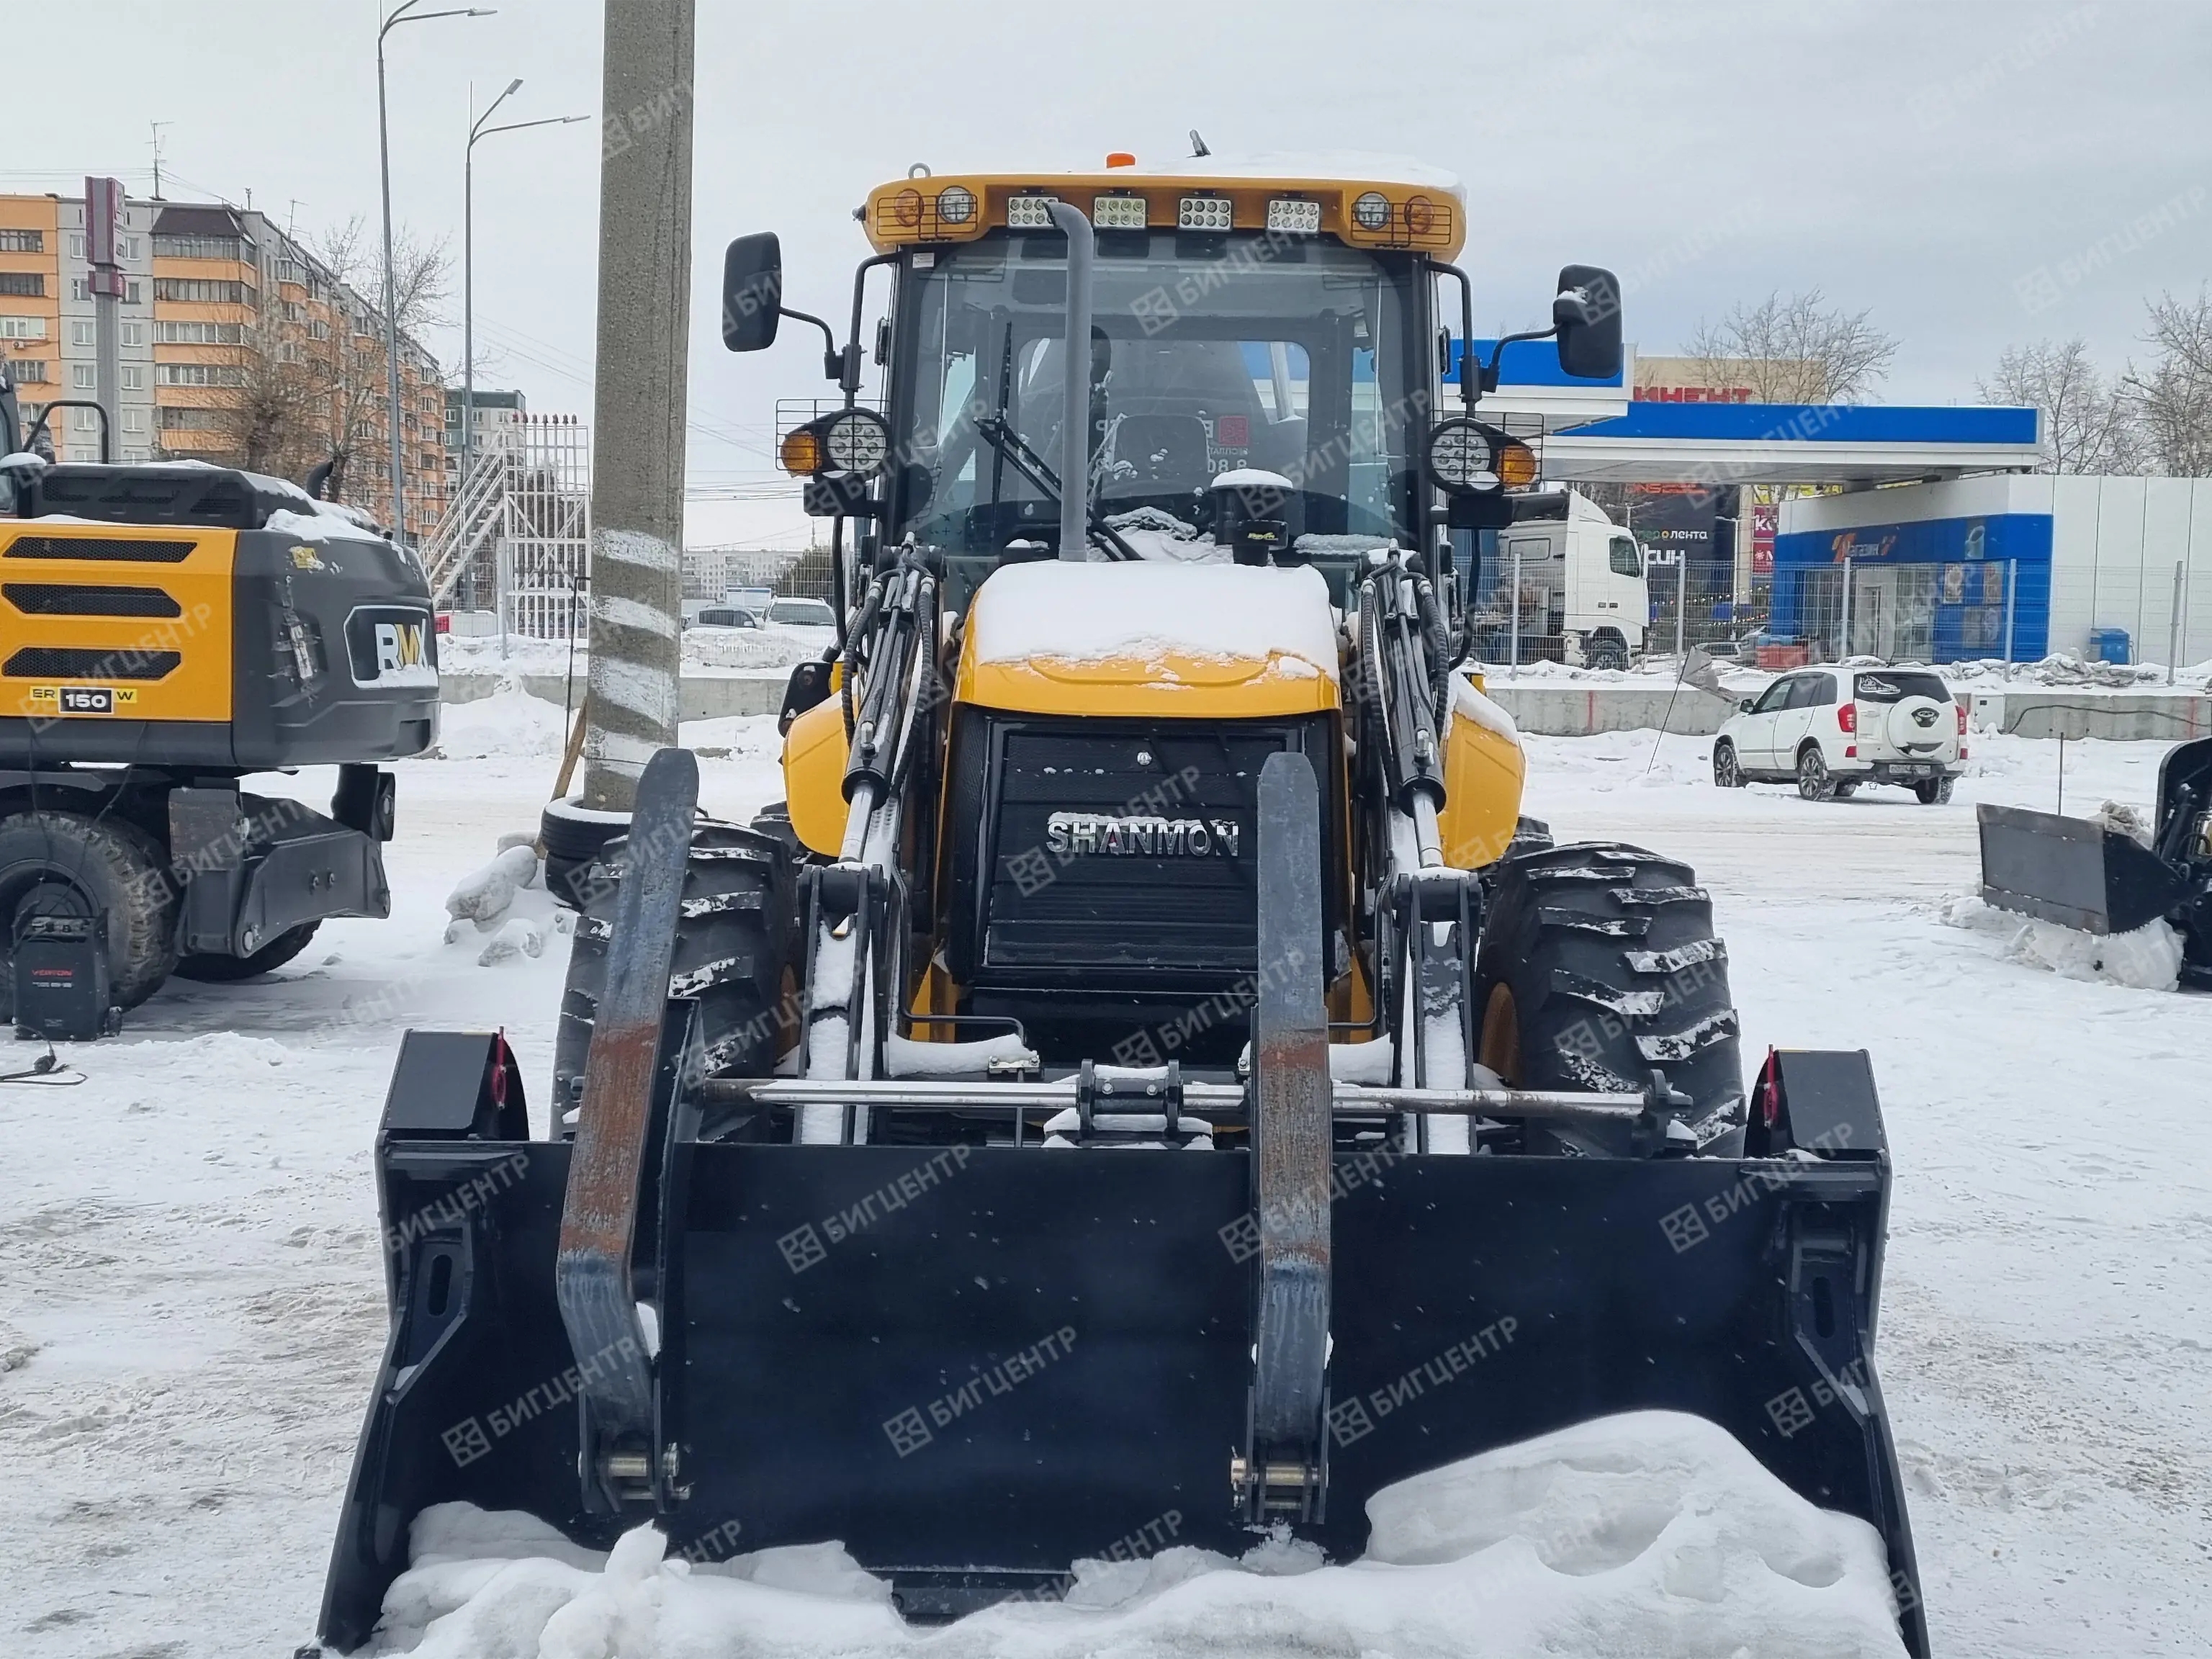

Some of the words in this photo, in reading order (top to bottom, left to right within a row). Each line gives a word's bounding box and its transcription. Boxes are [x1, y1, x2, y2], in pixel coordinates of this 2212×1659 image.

[1670, 530, 1708, 539] лента
[374, 618, 428, 670] RMX
[33, 688, 55, 698] ER
[66, 693, 107, 708] 150
[117, 691, 134, 701] W
[1046, 820, 1239, 857] SHANMON
